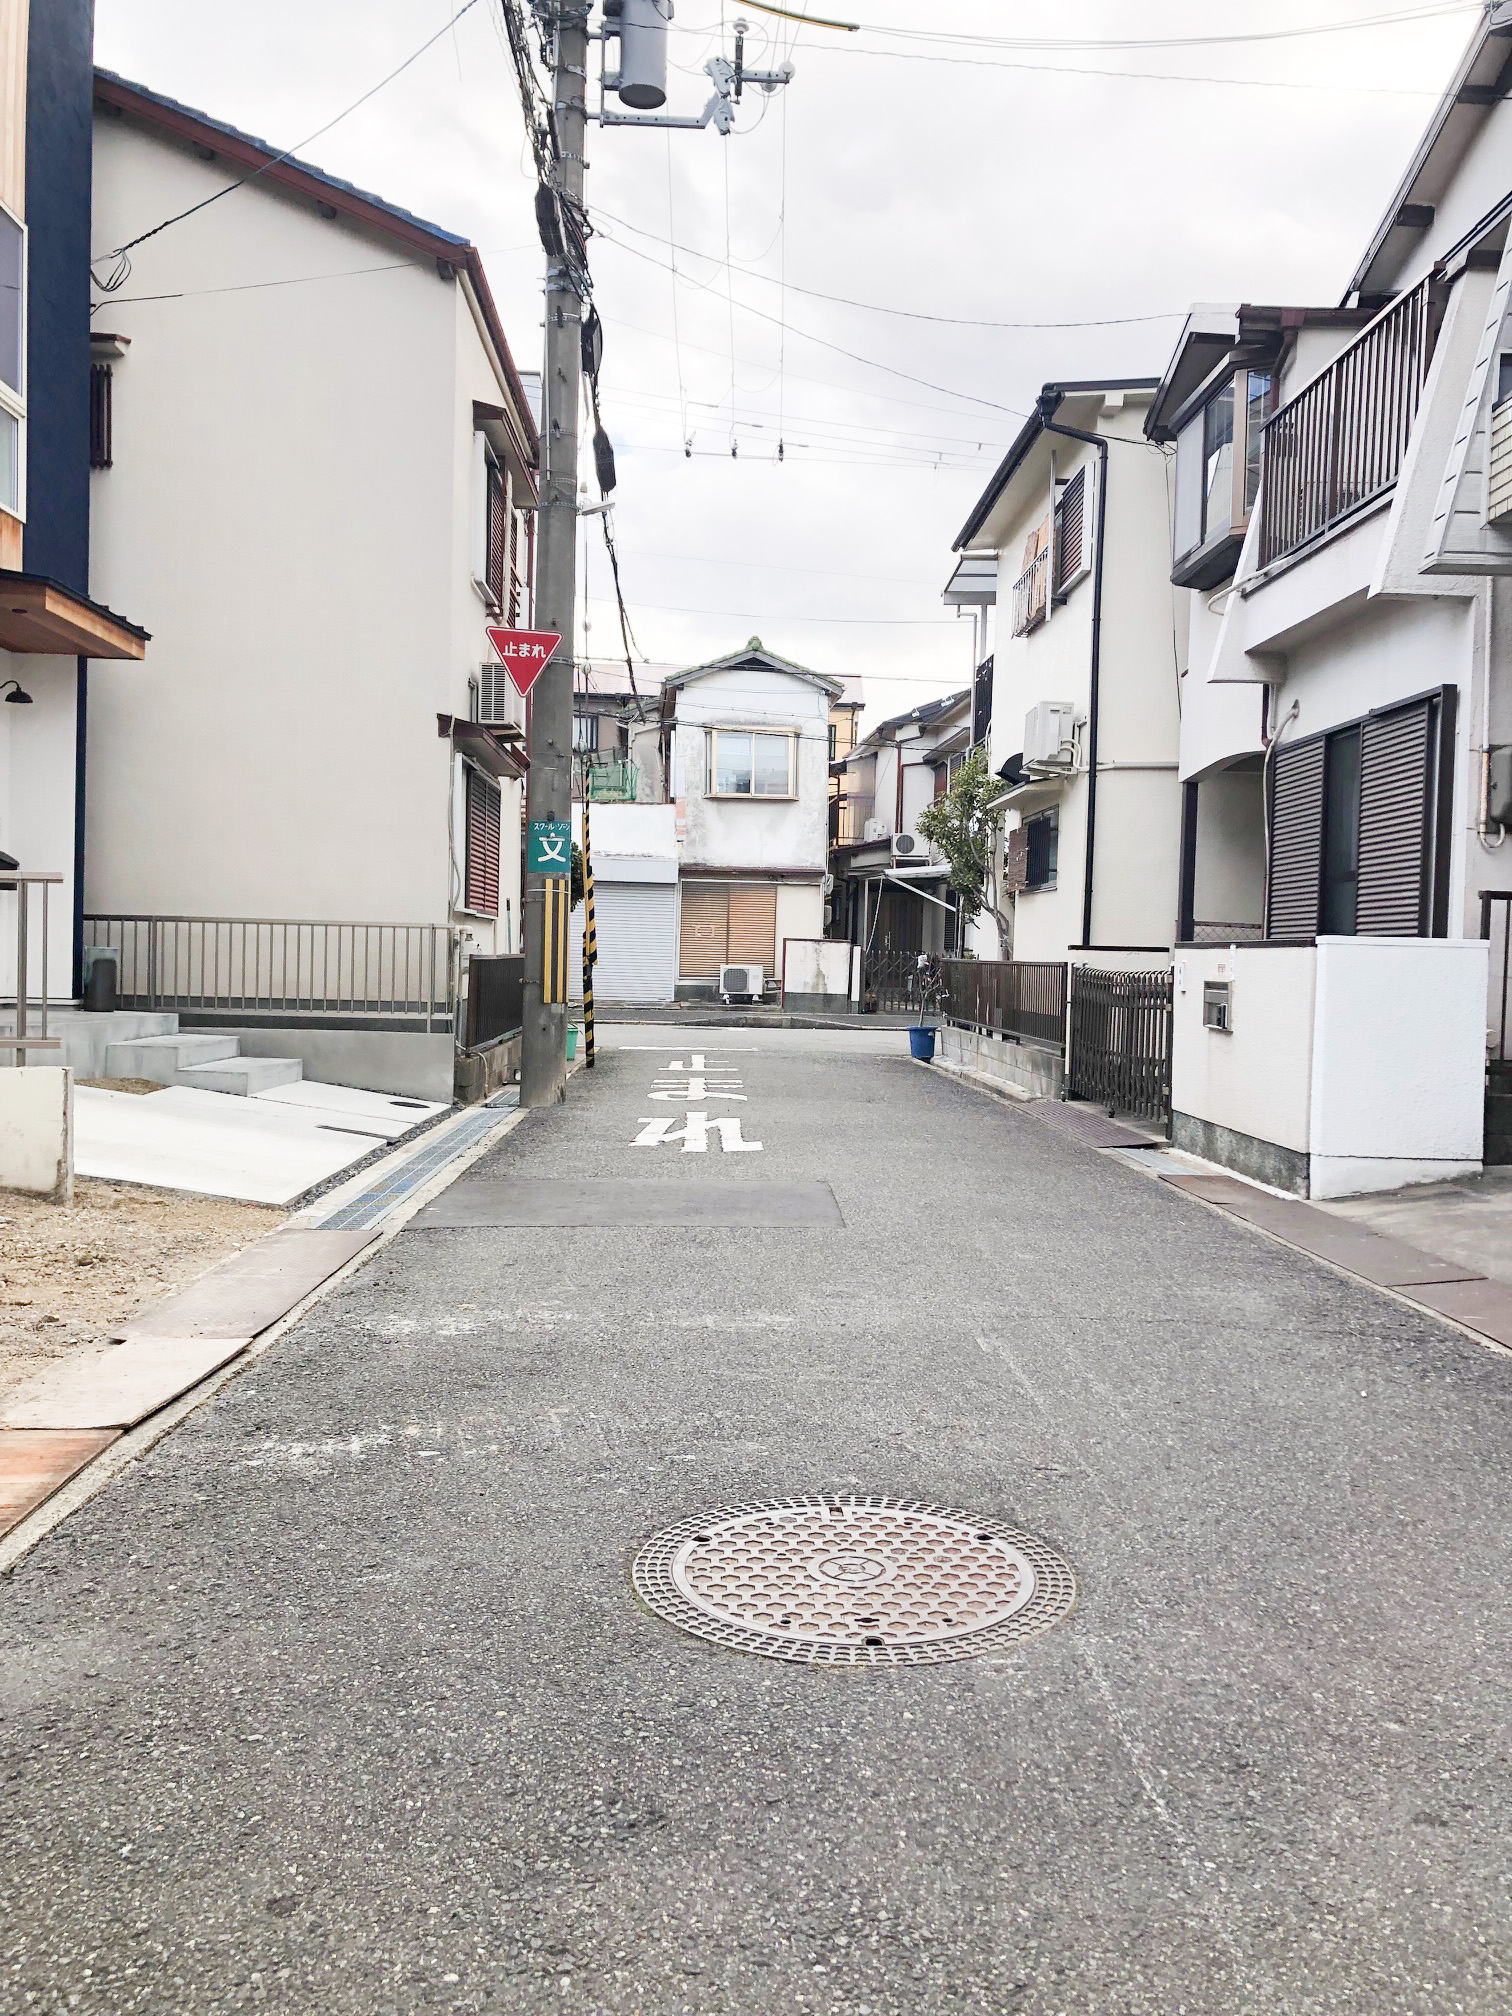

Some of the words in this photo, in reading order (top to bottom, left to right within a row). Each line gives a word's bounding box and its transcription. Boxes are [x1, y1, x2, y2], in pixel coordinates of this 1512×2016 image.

[502, 641, 547, 659] 止まれ
[537, 832, 567, 863] 文
[628, 1054, 764, 1153] 止まれ
